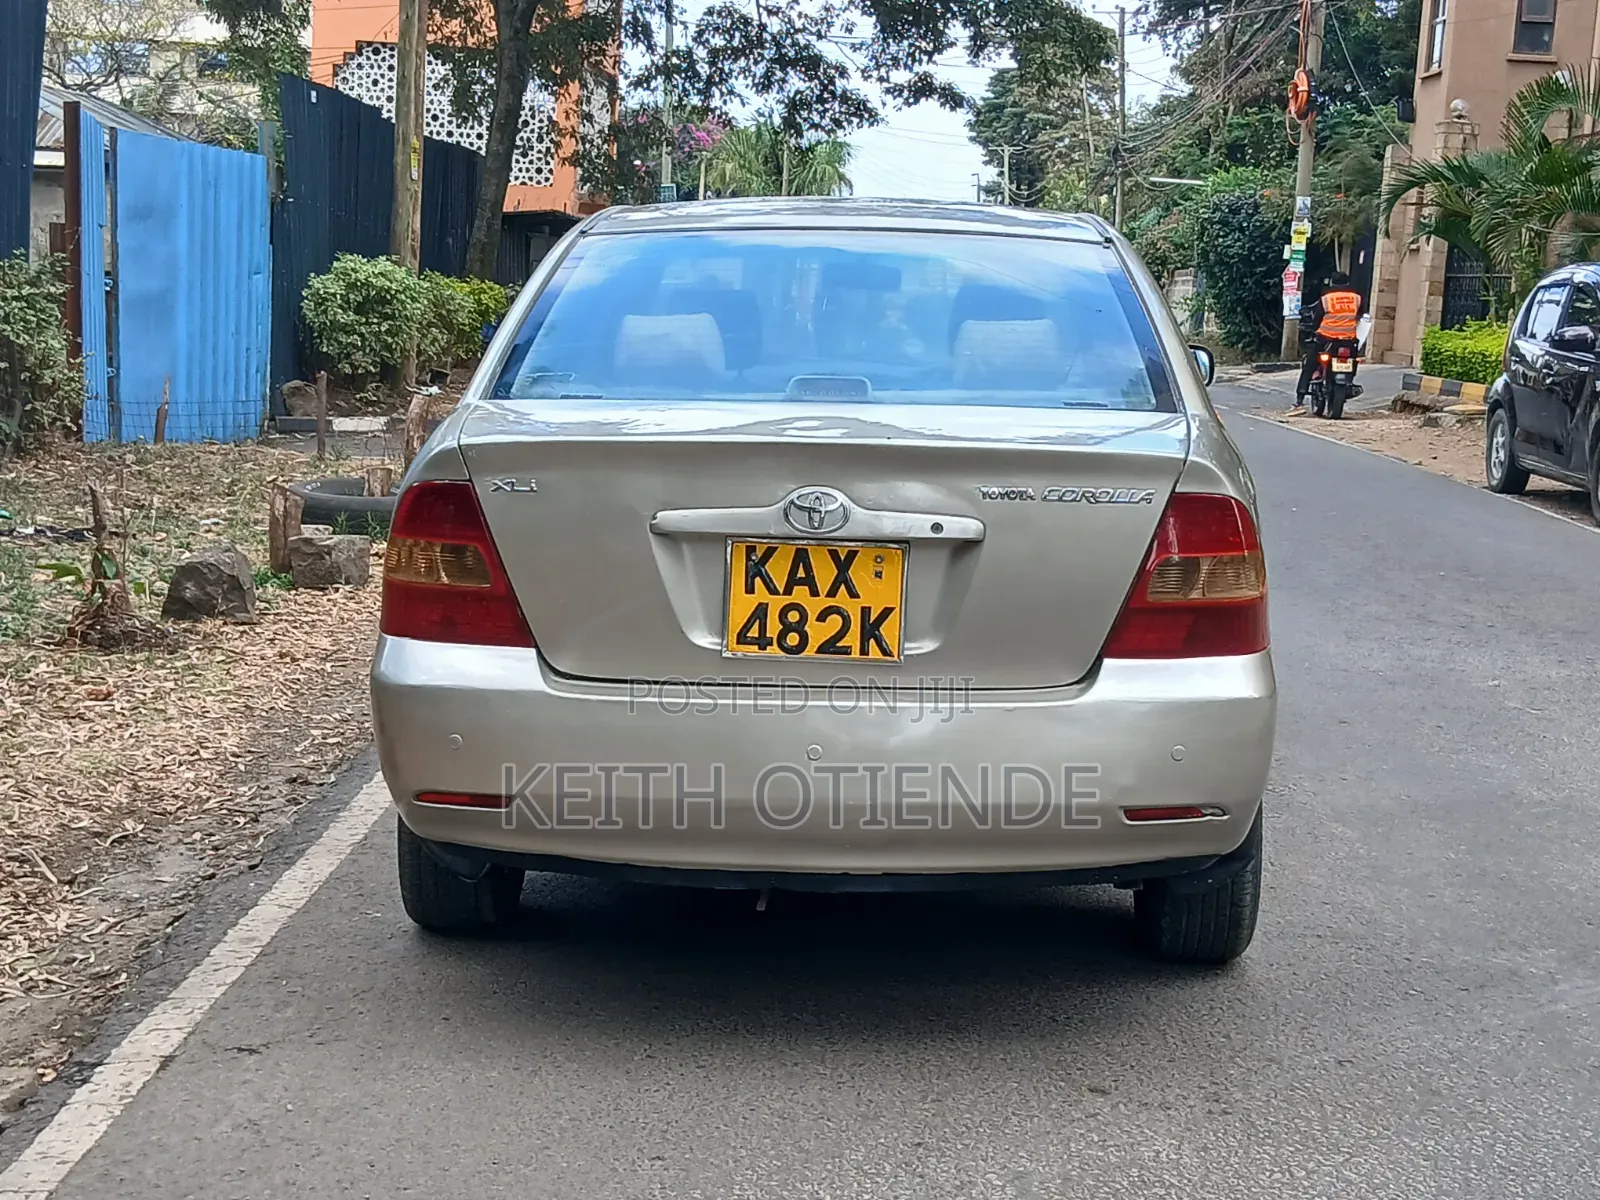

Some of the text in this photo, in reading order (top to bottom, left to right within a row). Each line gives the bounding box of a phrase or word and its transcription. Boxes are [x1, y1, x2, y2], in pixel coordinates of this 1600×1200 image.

[978, 486, 1156, 505] TOYOTA COROLLA
[743, 544, 862, 600] KAX
[735, 601, 897, 658] 482K
